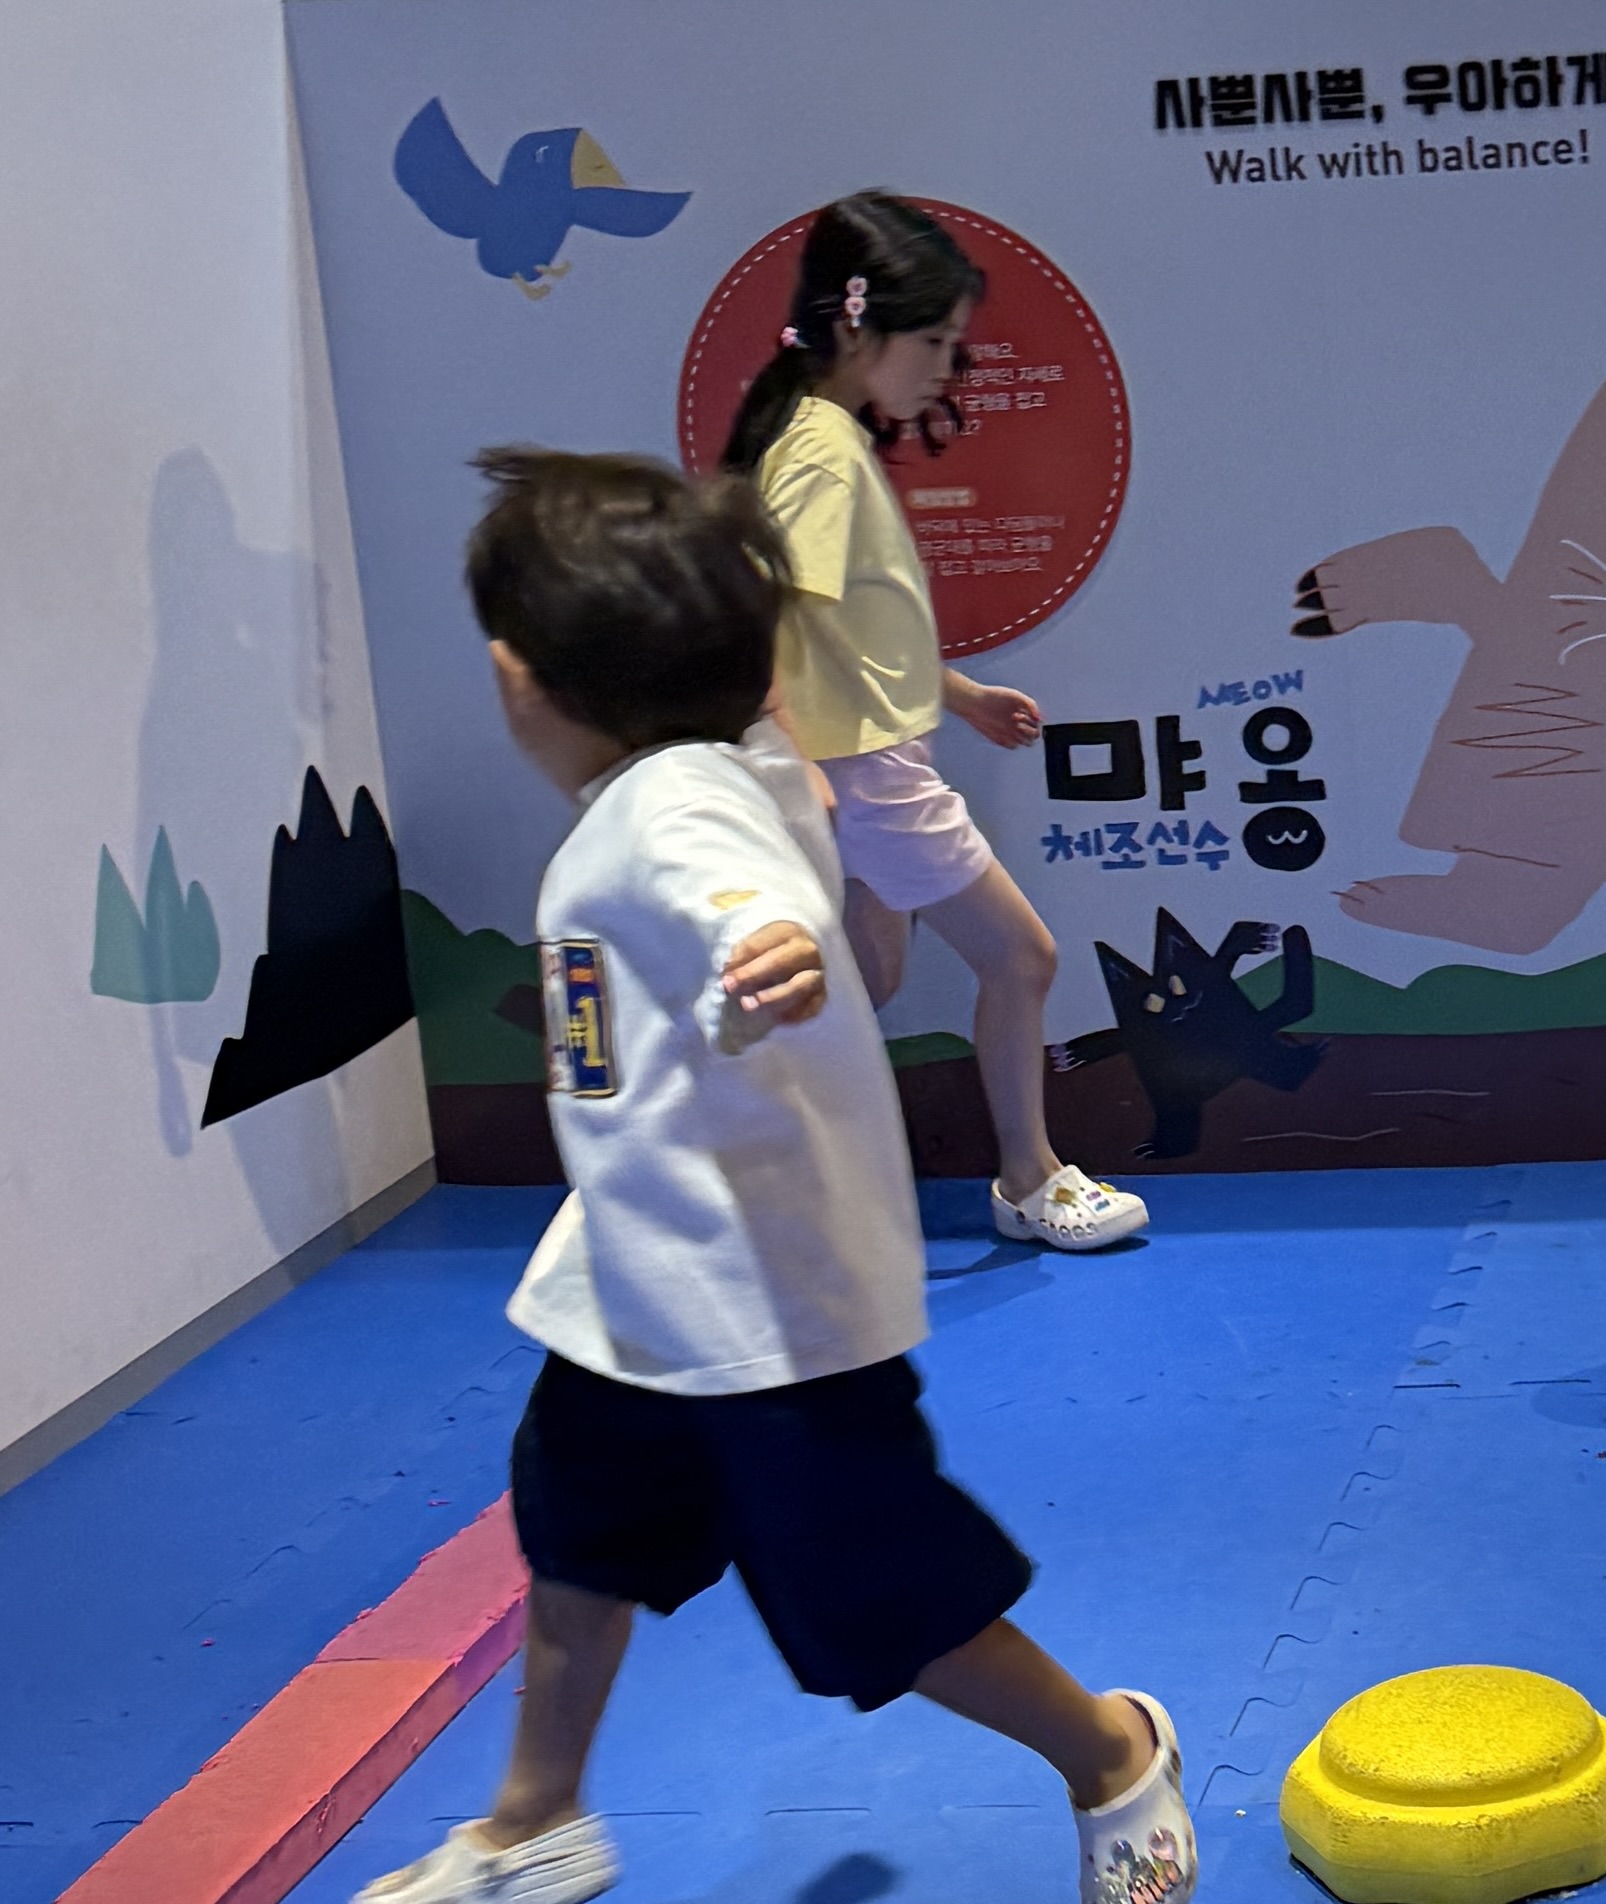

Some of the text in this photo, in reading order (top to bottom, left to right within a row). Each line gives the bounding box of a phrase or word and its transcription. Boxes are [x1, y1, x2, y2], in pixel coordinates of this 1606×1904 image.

[1153, 66, 1386, 132] 사뿐사뿐,
[1206, 129, 1591, 185] Walk with balance!
[1197, 669, 1304, 709] MEOW
[1041, 819, 1231, 871] 체조선수
